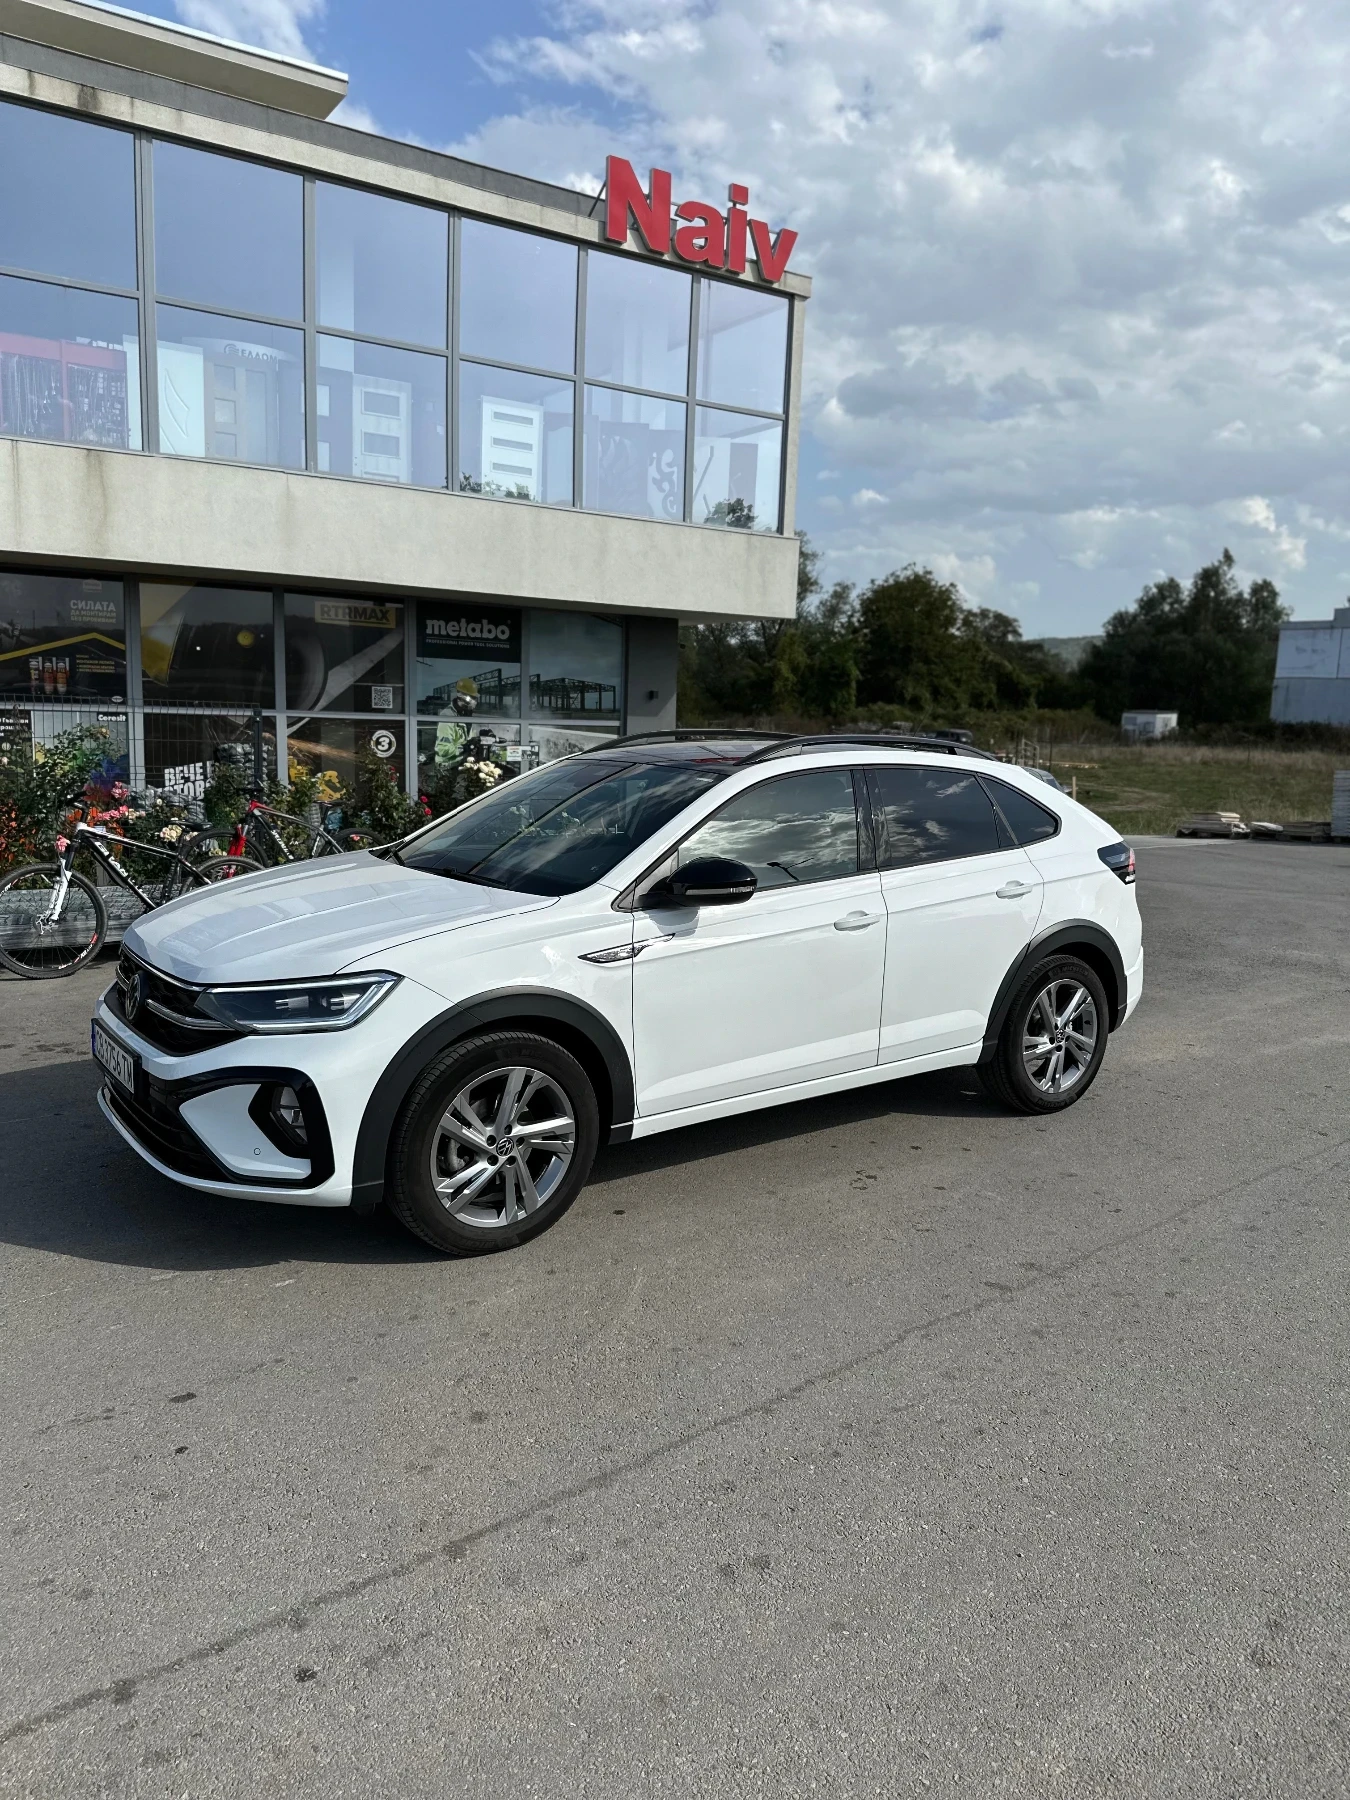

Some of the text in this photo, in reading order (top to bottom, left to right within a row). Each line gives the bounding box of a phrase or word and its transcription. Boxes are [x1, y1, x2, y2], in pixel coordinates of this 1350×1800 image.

[605, 155, 798, 284] Naiv
[70, 599, 116, 611] СИЛАТА
[320, 604, 390, 622] RTRMAX
[426, 618, 510, 640] metabo
[98, 714, 127, 722] Ceresit
[377, 736, 390, 751] 3
